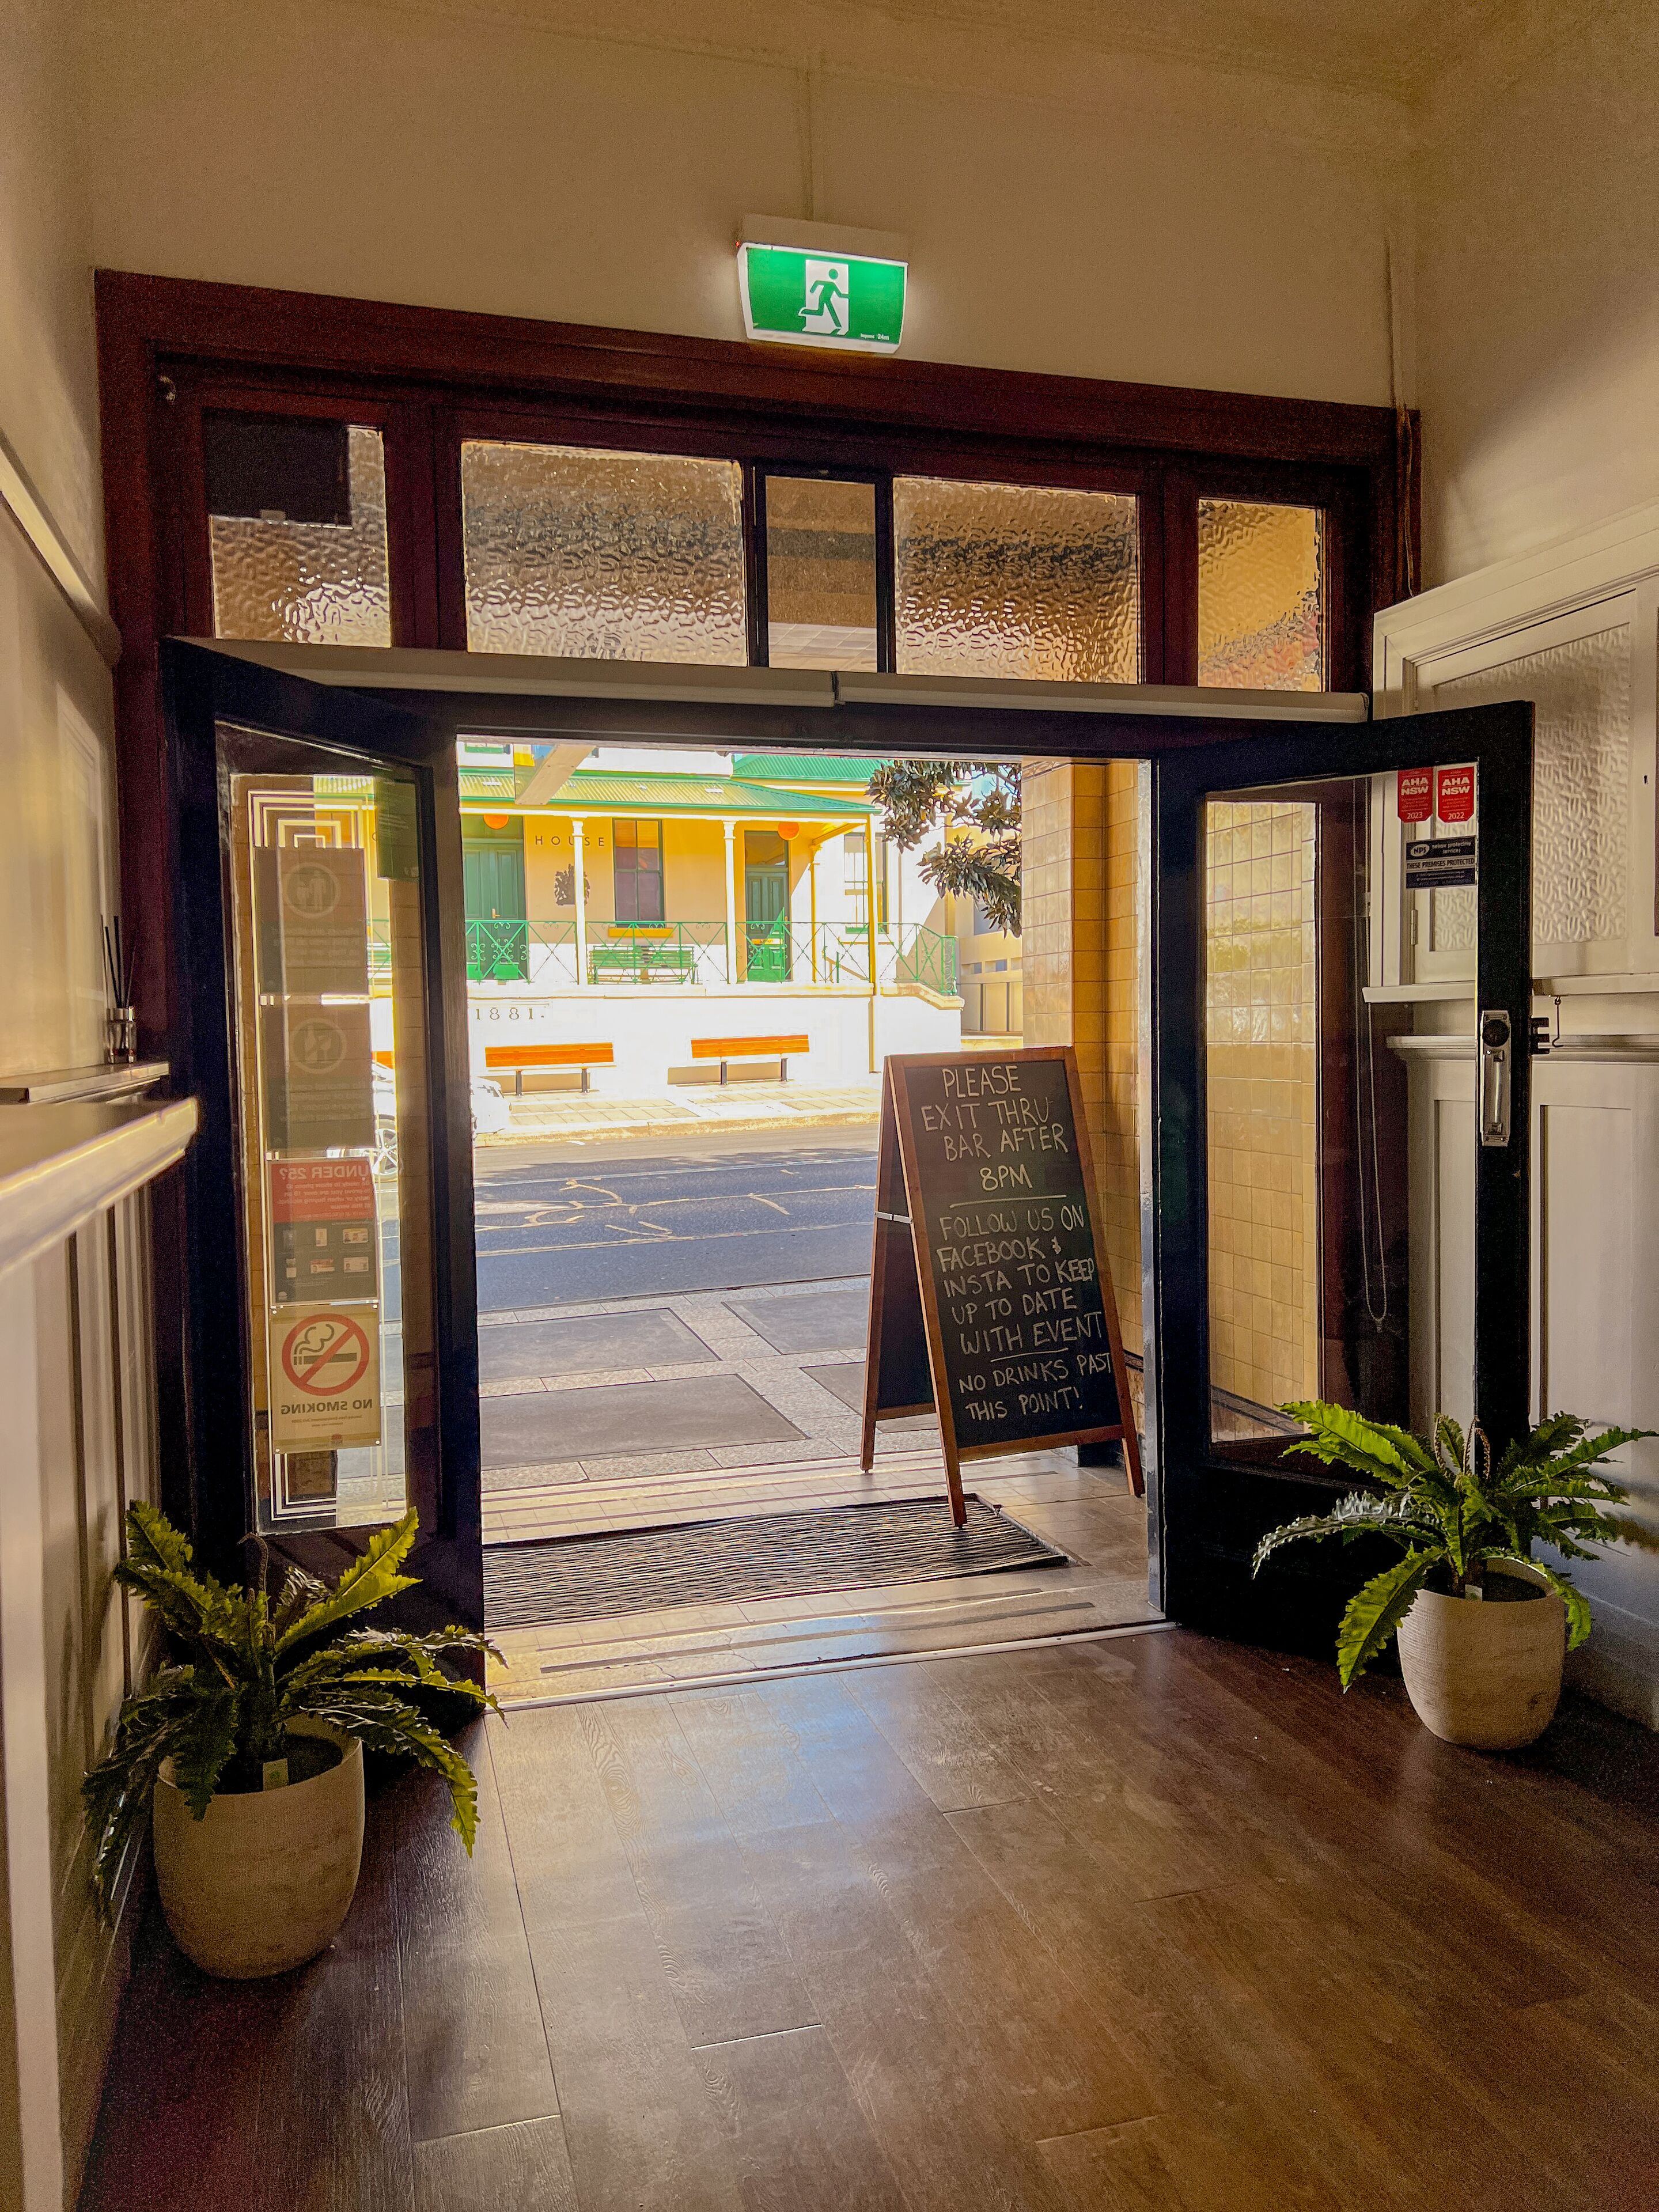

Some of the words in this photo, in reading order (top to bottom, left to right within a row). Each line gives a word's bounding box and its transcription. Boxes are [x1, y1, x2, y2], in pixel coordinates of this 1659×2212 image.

[1401, 786, 1429, 796] NSW
[1402, 777, 1429, 787] AHA
[1441, 786, 1470, 796] NSW
[1442, 777, 1470, 787] AHA
[1407, 812, 1423, 820] 2023
[1448, 812, 1465, 820] 2022
[535, 835, 605, 847] HOUSE
[1422, 860, 1445, 868] PREMISES
[1446, 858, 1475, 866] PROTECTED
[942, 1064, 1022, 1098] PLEASE
[921, 1103, 982, 1132] EXIT
[988, 1097, 1055, 1126] THRU
[944, 1132, 991, 1162] BAR
[1000, 1123, 1069, 1154] AFTER
[979, 1164, 1033, 1192] 8PM
[939, 1210, 1017, 1241] FOLLOW
[1027, 1207, 1055, 1232] US
[1061, 1205, 1085, 1229] ON
[936, 1237, 1046, 1272] FACEBOOK
[943, 1269, 1013, 1299] INSTA
[1017, 1262, 1051, 1287] TO
[1056, 1256, 1094, 1283] KEEP
[951, 1303, 977, 1325] UP
[984, 1298, 1012, 1321] TO
[1022, 1287, 1077, 1316] DATE
[959, 1324, 1024, 1355] WITH
[1033, 1311, 1103, 1347] EVENT
[959, 1373, 987, 1394] NO
[992, 1361, 1069, 1388] DRINKS
[1077, 1351, 1111, 1376] PAST
[965, 1400, 1008, 1421] THIS
[1018, 1385, 1084, 1415] POINT!
